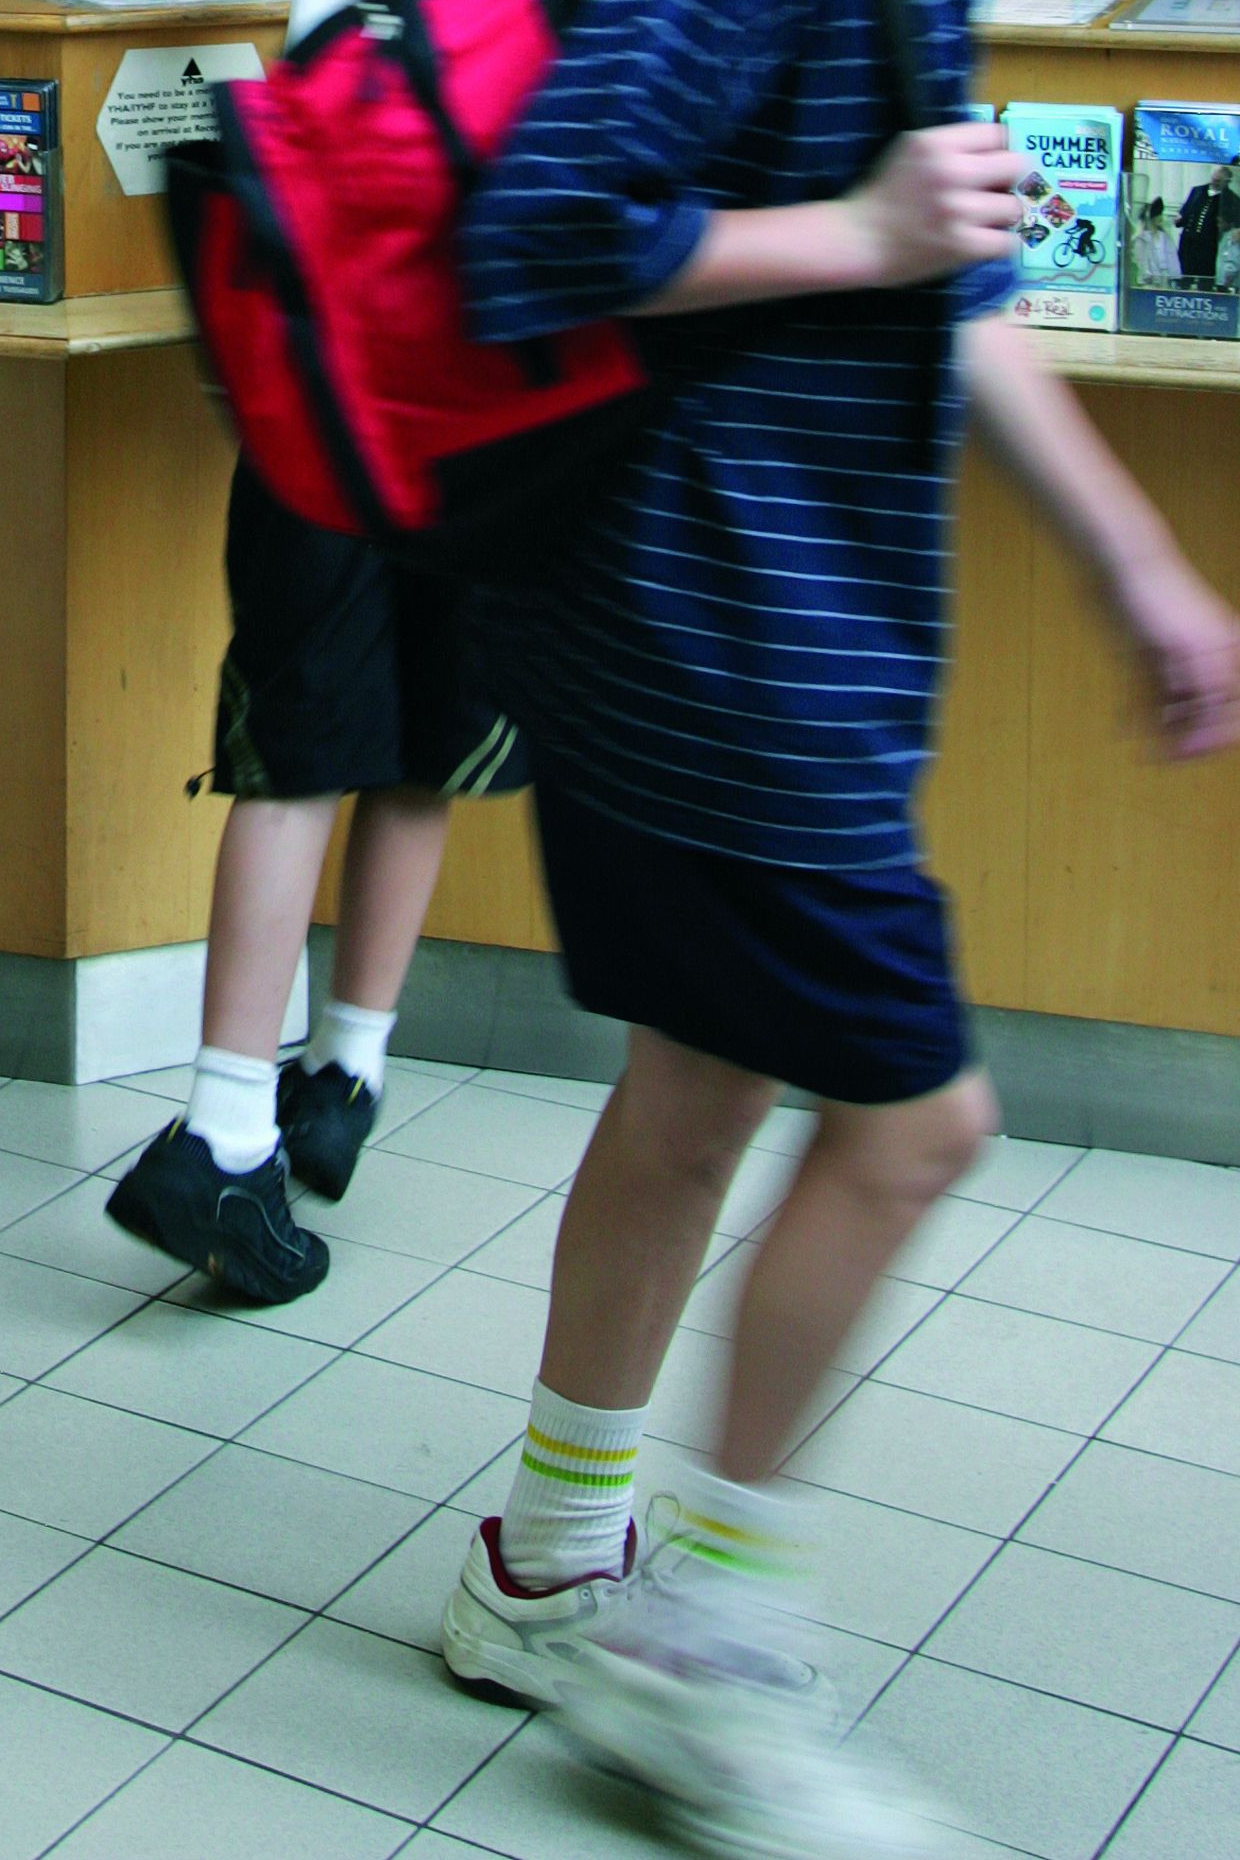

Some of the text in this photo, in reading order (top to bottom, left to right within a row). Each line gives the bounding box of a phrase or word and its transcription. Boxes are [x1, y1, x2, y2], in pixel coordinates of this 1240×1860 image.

[117, 91, 135, 101] You
[137, 91, 160, 100] need
[162, 90, 174, 98] to
[174, 89, 185, 97] be
[170, 100, 189, 111] stay
[0, 114, 33, 124] TICKETS
[110, 116, 140, 126] Please
[141, 114, 165, 125] show
[167, 114, 189, 125] your
[136, 129, 149, 138] on
[1160, 123, 1230, 143] ROYAL
[124, 142, 141, 152] you
[1025, 134, 1109, 154] SUMMER
[1041, 152, 1108, 171] CAMPS
[1155, 295, 1213, 311] EVENTS
[1155, 308, 1229, 322] ATTRACTIONS
